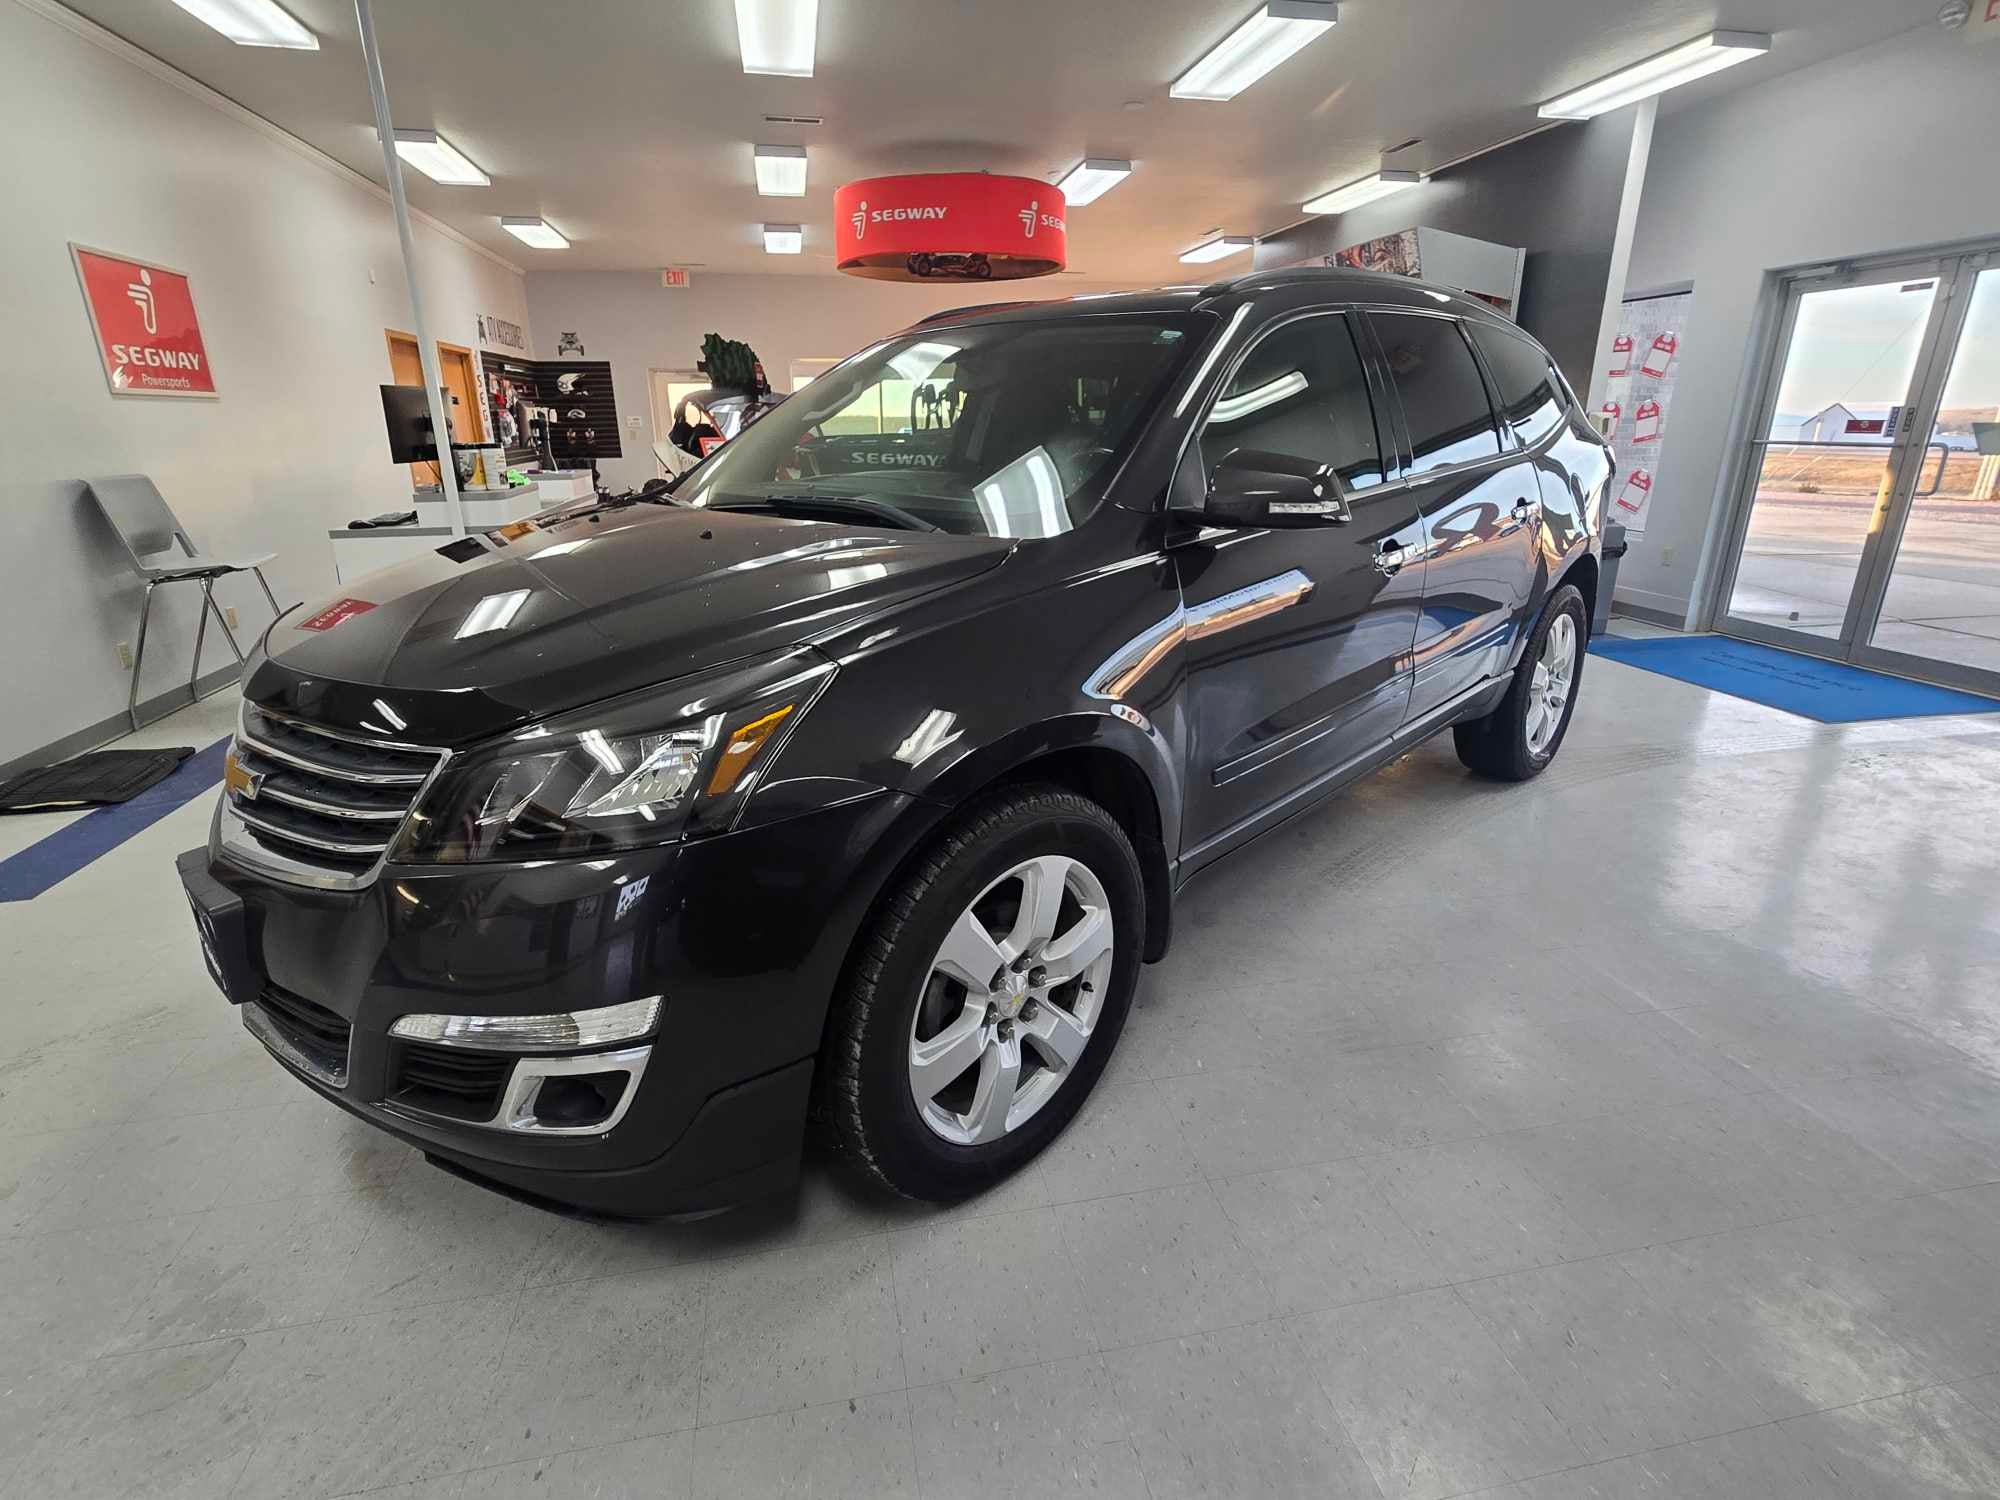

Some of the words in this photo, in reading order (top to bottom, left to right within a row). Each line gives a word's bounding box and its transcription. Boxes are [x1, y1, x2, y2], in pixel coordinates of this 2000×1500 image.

[871, 207, 947, 222] SEGWAY
[666, 271, 684, 285] EXIT
[112, 344, 199, 370] SEGWAY
[141, 374, 190, 388] Powersports
[851, 452, 938, 466] SEGWAY
